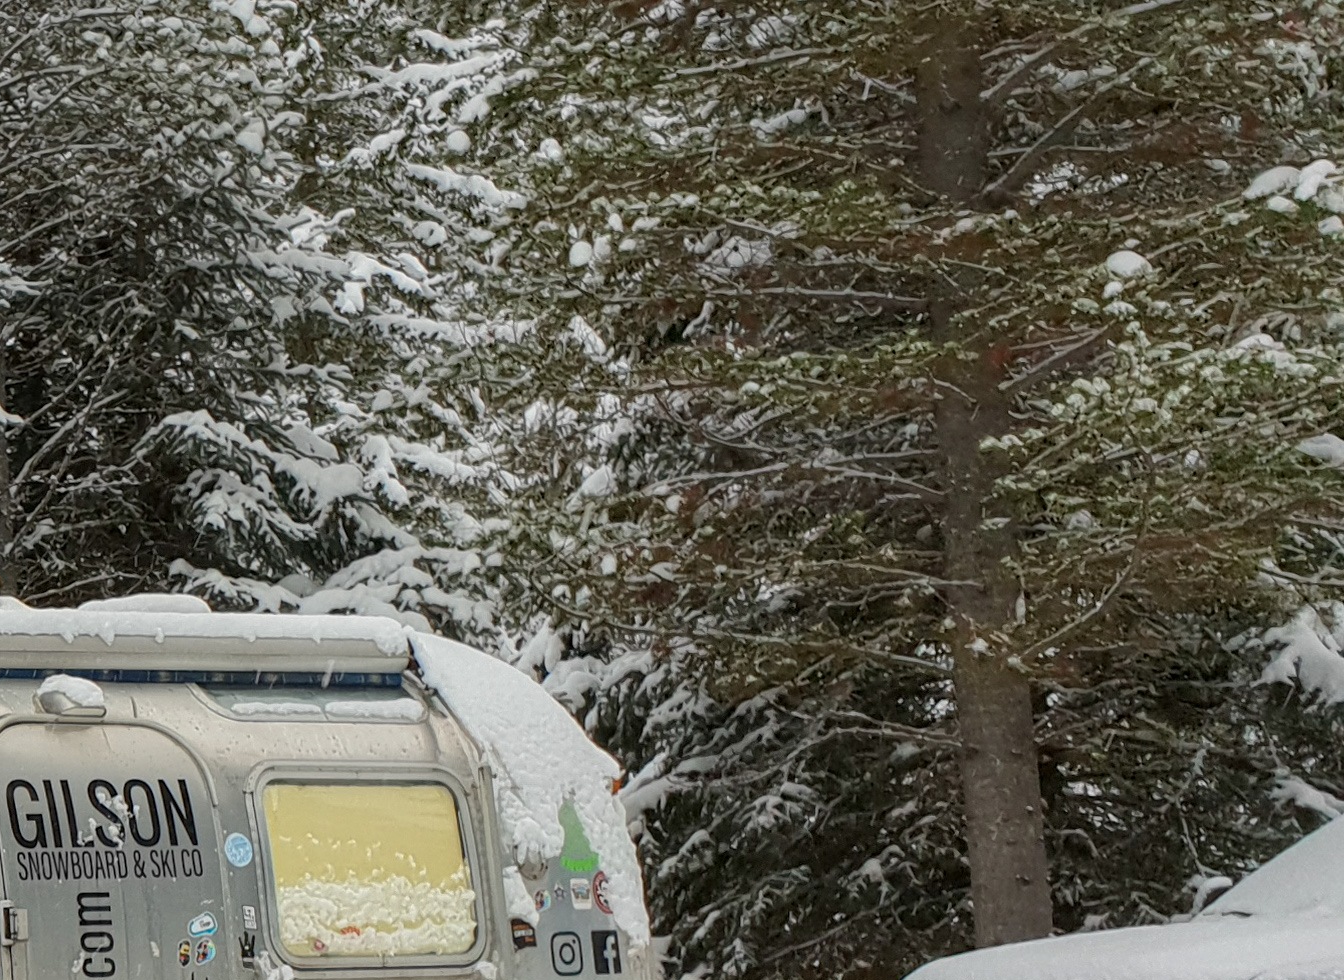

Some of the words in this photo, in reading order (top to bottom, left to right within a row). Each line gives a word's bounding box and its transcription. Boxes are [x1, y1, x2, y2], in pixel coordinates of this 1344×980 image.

[6, 779, 199, 848] GILSON
[18, 850, 128, 881] SNOWBOARD
[134, 850, 146, 880] &
[150, 849, 178, 878] SKI
[180, 848, 204, 878] CO
